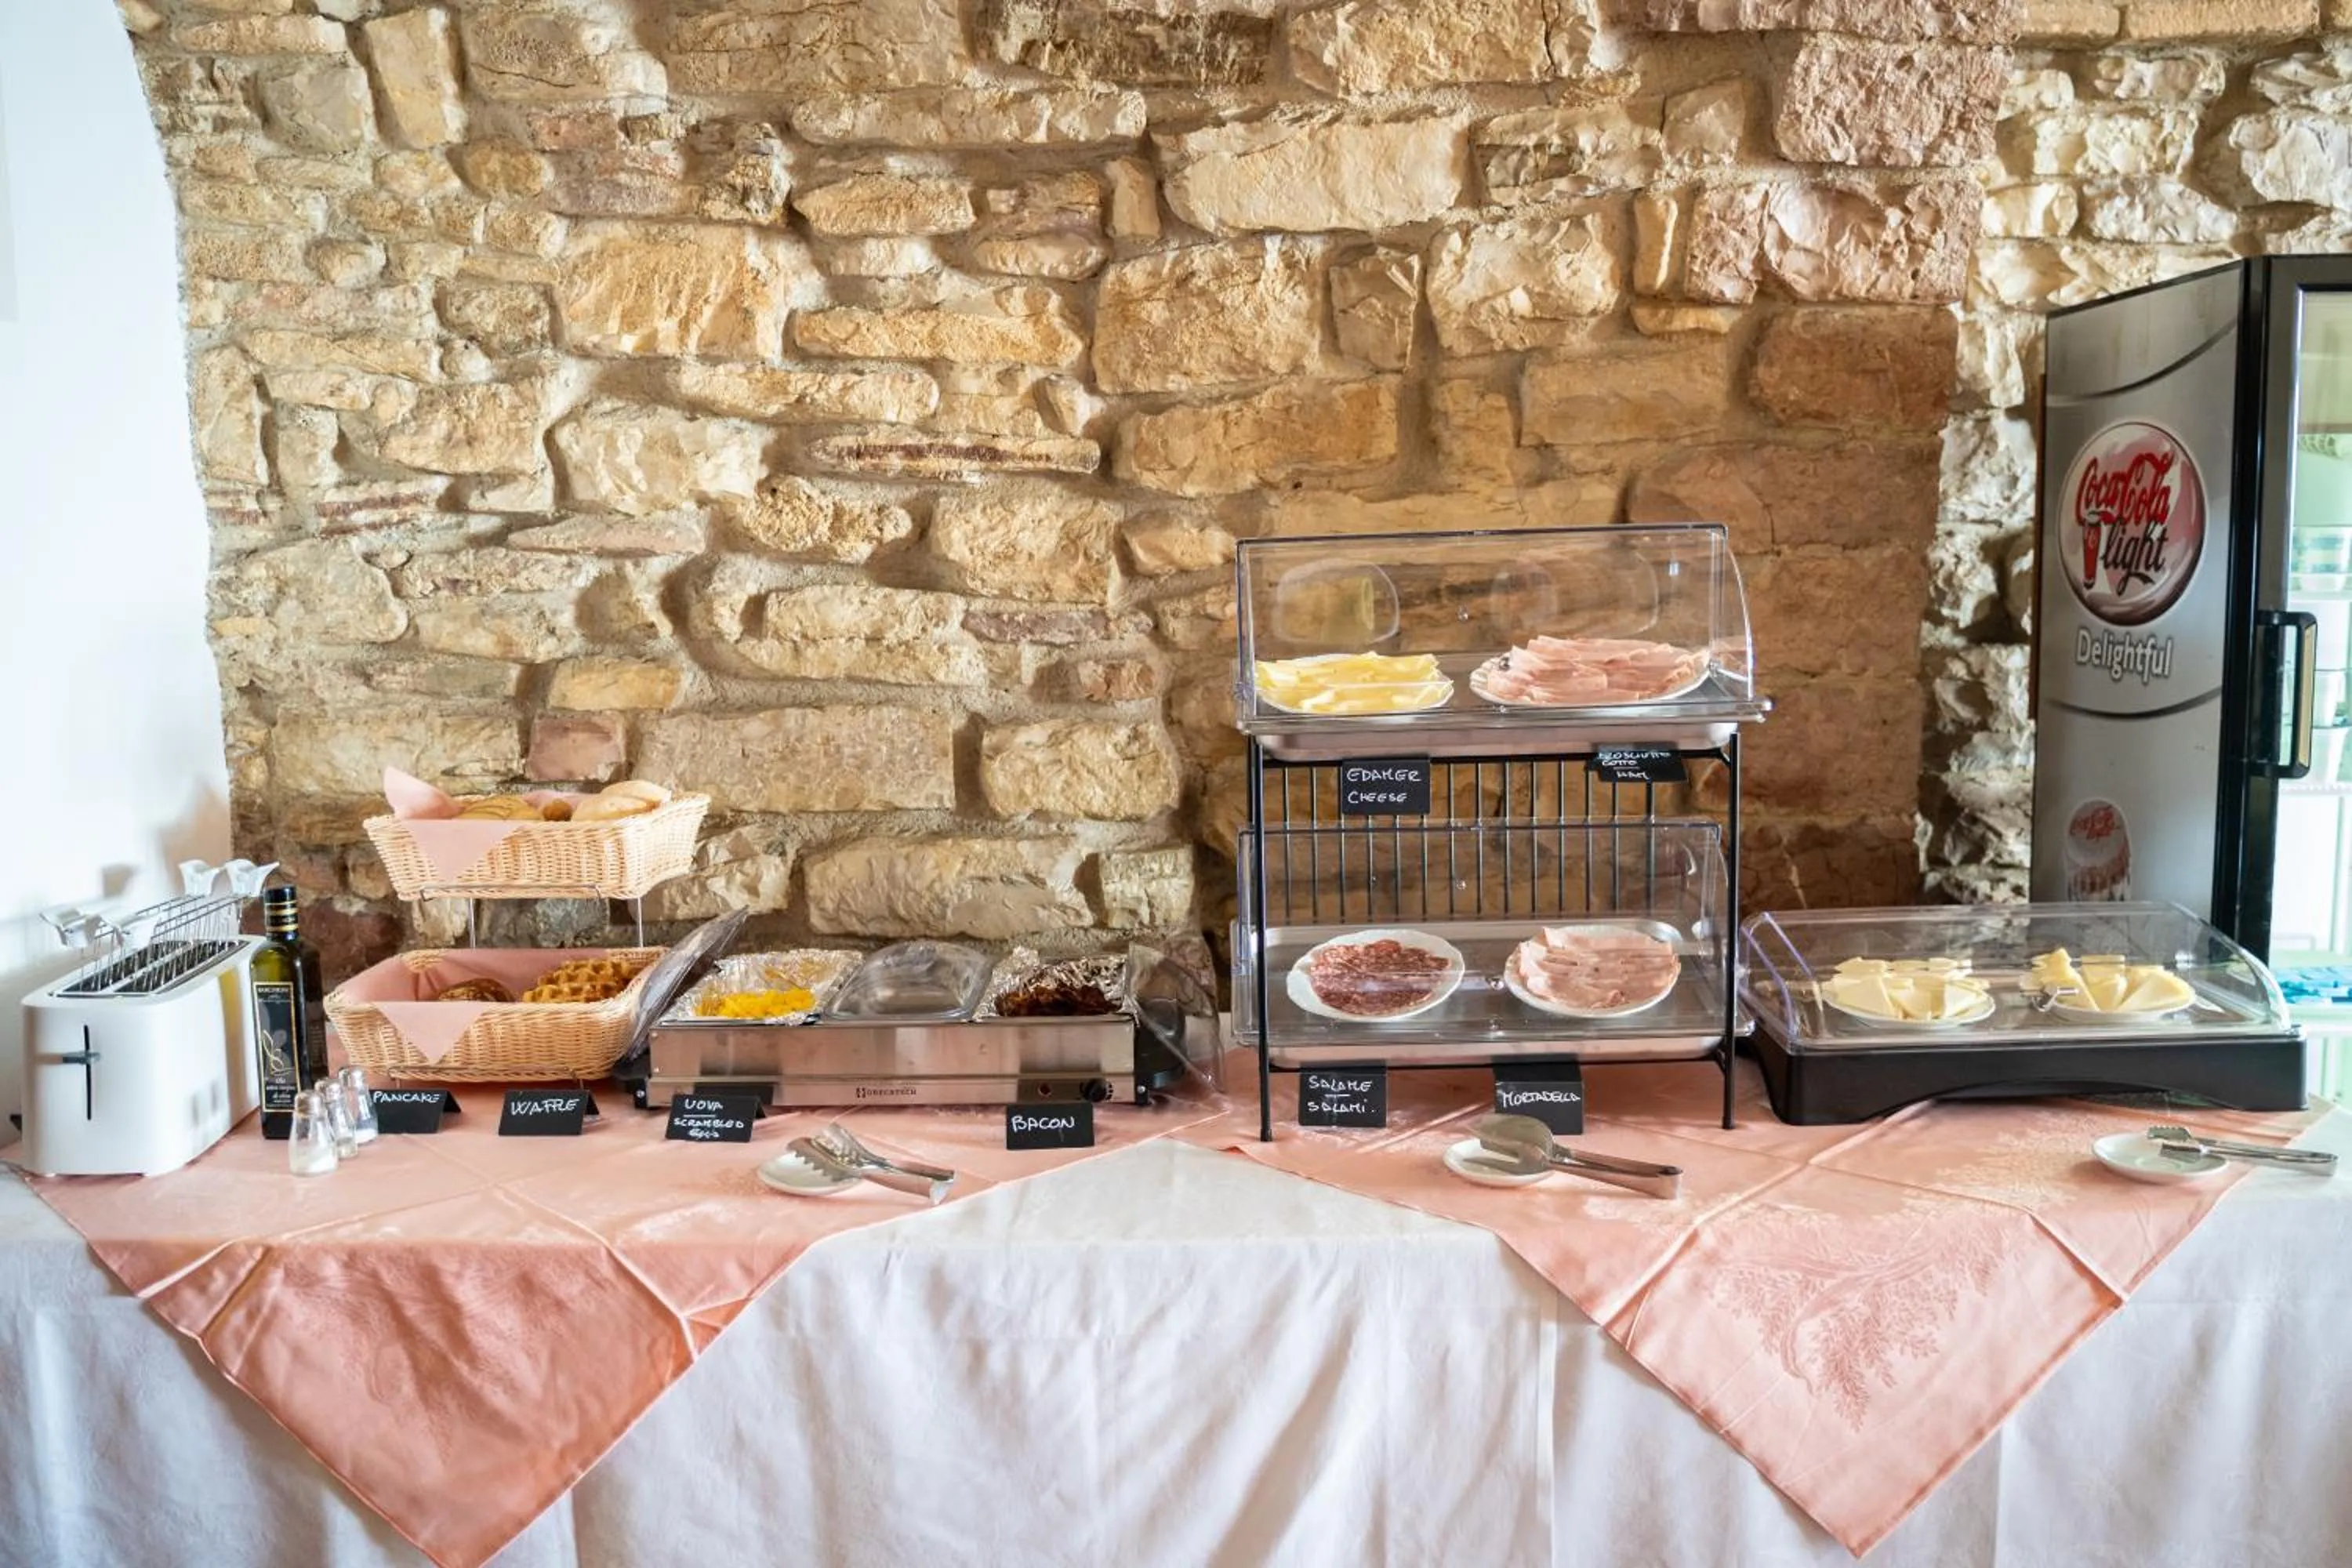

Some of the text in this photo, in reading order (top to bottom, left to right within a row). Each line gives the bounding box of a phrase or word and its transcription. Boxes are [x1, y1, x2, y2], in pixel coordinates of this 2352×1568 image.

[2101, 519, 2169, 596] light
[2076, 628, 2172, 684] Delightful
[1348, 791, 1407, 804] CHEESE
[1308, 1075, 1373, 1092] SALAME
[373, 1091, 440, 1103] PANCAKE
[684, 1098, 724, 1111] UOVA
[1498, 1090, 1581, 1108] MORTADELLA
[1011, 1115, 1075, 1133] BACON
